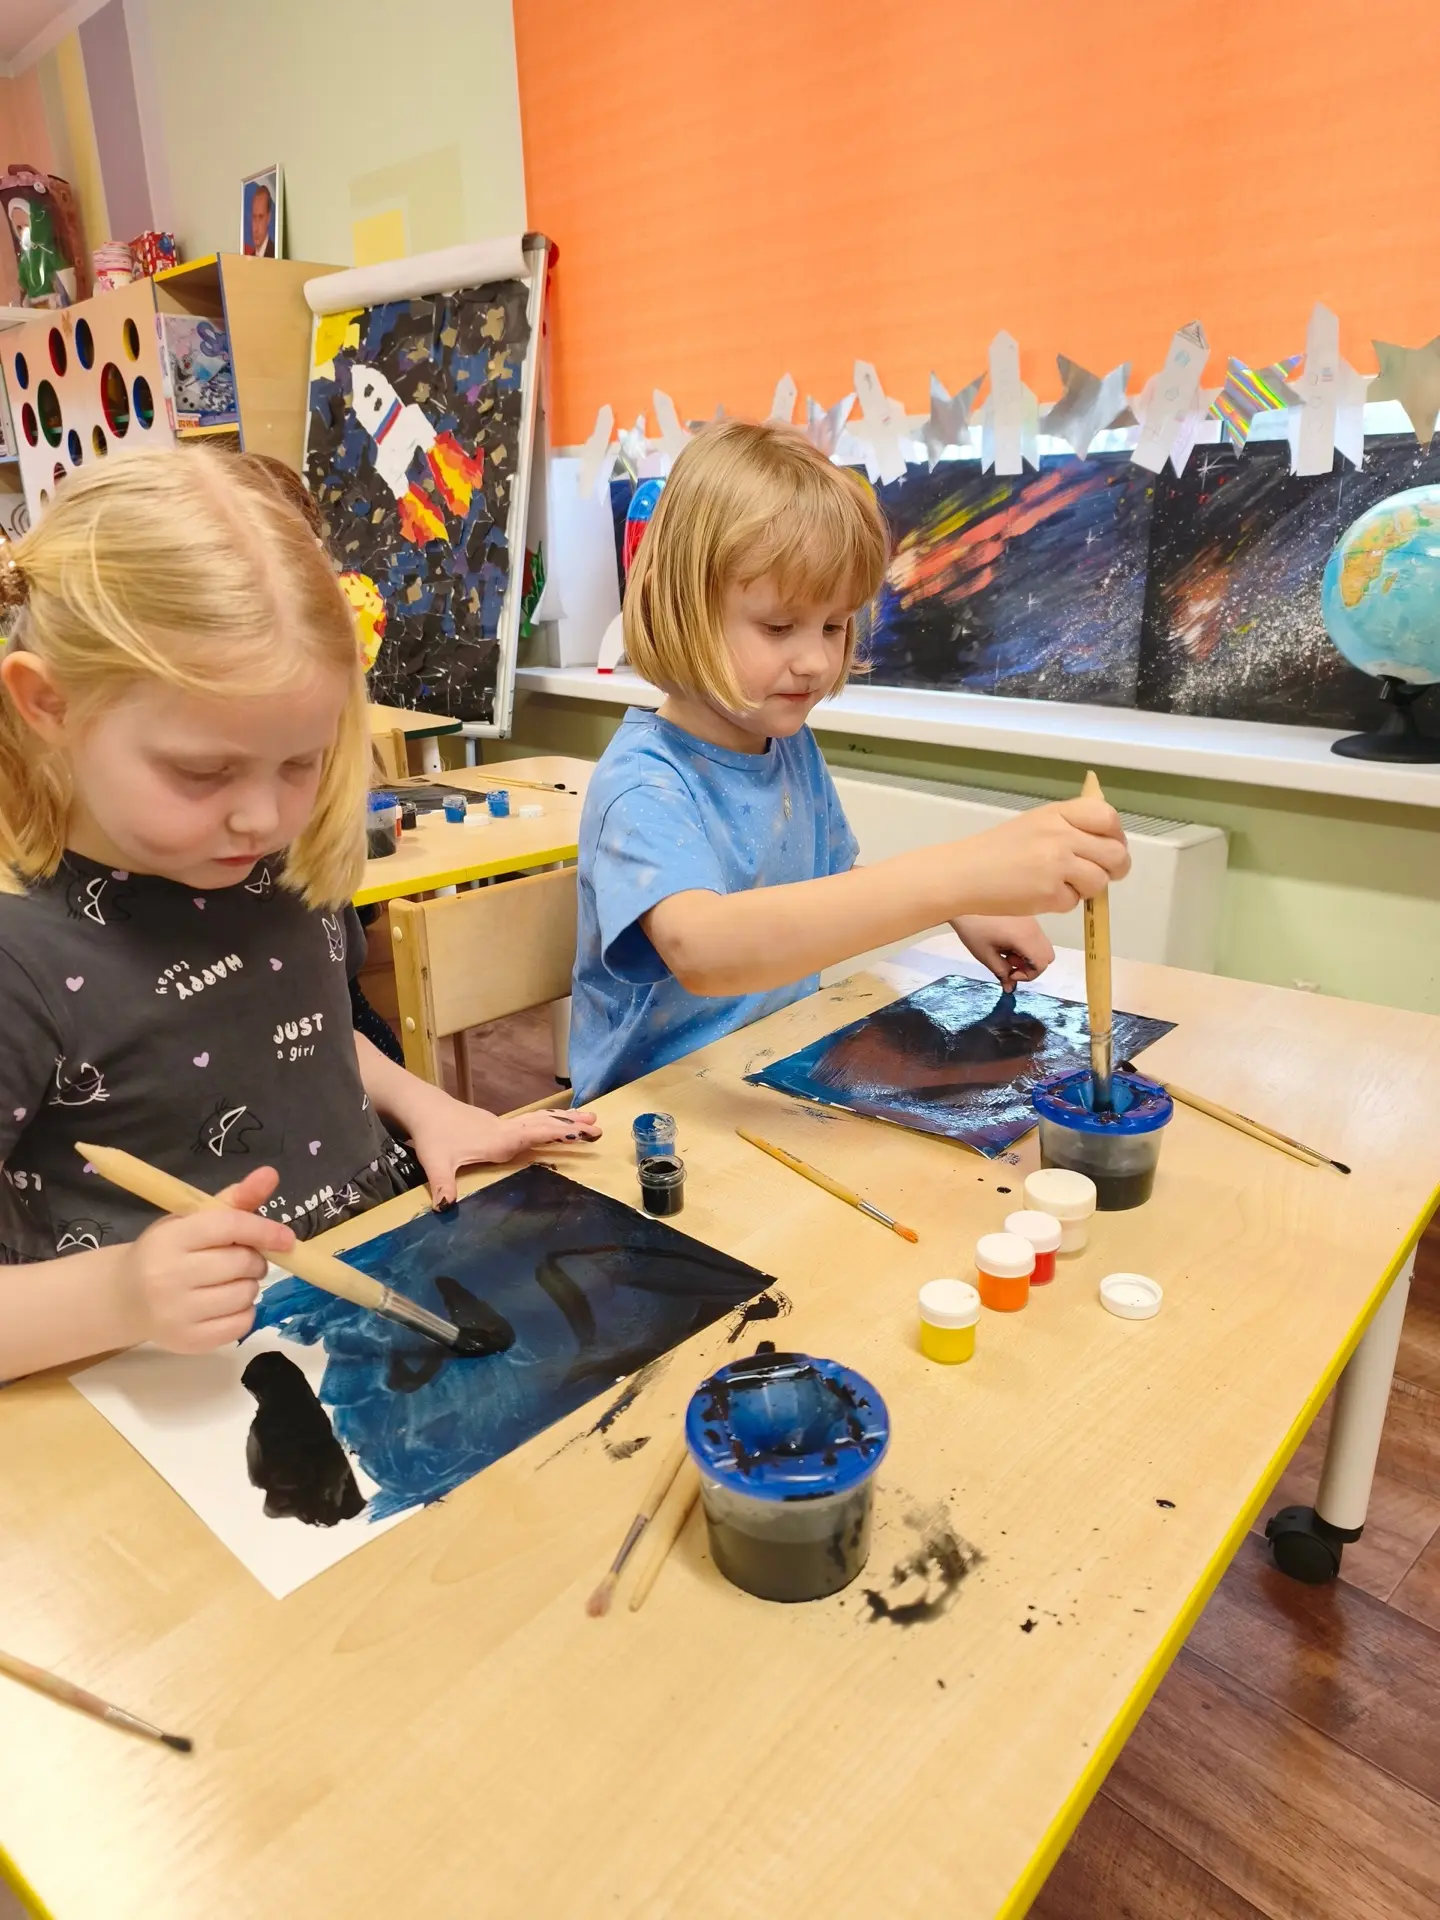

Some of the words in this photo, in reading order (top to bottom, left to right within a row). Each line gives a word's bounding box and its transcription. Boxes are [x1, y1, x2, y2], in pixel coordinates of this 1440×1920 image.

[155, 960, 190, 994] today
[175, 953, 244, 1000] HAPPY
[273, 1012, 324, 1044] JUST
[276, 1050, 284, 1060] a
[289, 1044, 315, 1062] girl
[3, 1170, 42, 1191] ST
[257, 1195, 287, 1217] tod
